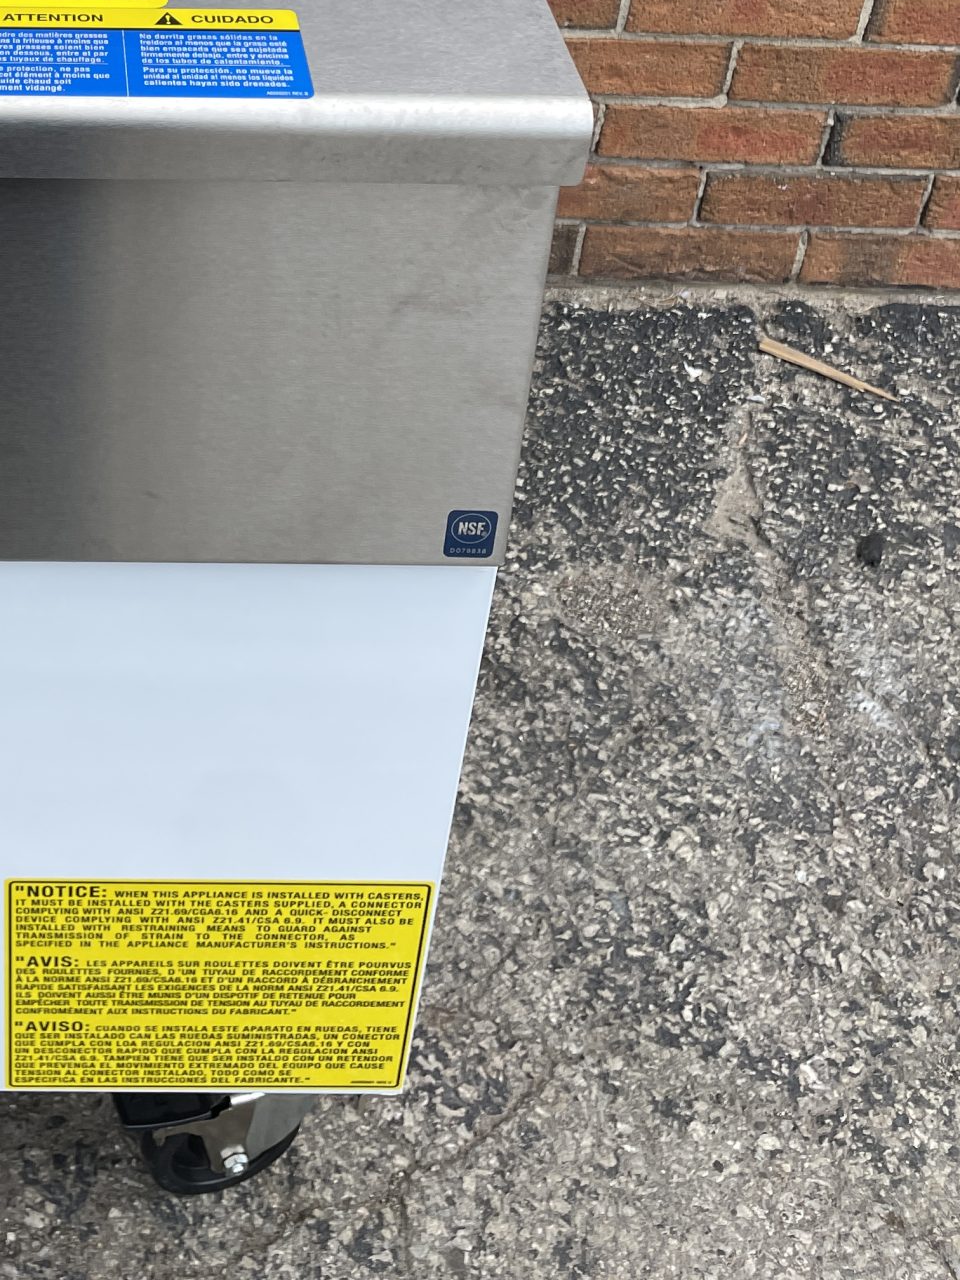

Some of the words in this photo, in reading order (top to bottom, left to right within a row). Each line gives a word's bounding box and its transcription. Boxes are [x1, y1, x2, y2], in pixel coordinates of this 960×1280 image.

[3, 13, 103, 22] ATTENTION
[191, 15, 274, 24] CUIDADO
[457, 521, 486, 536] NSF
[15, 885, 107, 898] "NOTICE:
[153, 891, 179, 899] THIS
[183, 891, 247, 899] APPLIANCE
[334, 892, 364, 900] WITH
[368, 892, 423, 900] CASTERS,
[16, 899, 26, 907] IT
[31, 899, 63, 907] MUST
[68, 899, 83, 908] BE
[87, 900, 151, 908] INSTALLED
[155, 900, 186, 908] WITH
[190, 900, 212, 908] THE
[216, 900, 269, 908] CASTERS
[274, 900, 334, 909] SUPPLIED,
[338, 901, 346, 909] A
[351, 901, 422, 909] CONNECTOR
[15, 907, 79, 916] COMPLYING
[82, 908, 111, 916] WITH
[117, 908, 144, 916] ANSI
[245, 909, 268, 917] AND
[275, 909, 283, 917] A
[332, 909, 402, 917] DISCONNECT
[15, 916, 56, 924] DEVICE
[65, 916, 132, 924] COMPLYING
[177, 917, 205, 925] ANSI
[364, 918, 395, 926] ALSO
[399, 918, 414, 926] BE
[15, 924, 75, 932] INSTALLED
[206, 925, 246, 933] MEANS
[196, 933, 210, 941] TO
[222, 933, 243, 941] THE
[255, 933, 328, 941] CONNECTOR,
[127, 941, 188, 949] APPLIANCE
[196, 941, 297, 949] MANUFACTURER'S
[15, 956, 79, 967] "AVIS:
[273, 961, 322, 969] DOIVENT
[326, 960, 354, 969] ÊTRE
[358, 961, 412, 969] POURVUS
[14, 1021, 90, 1032] "AVISO:
